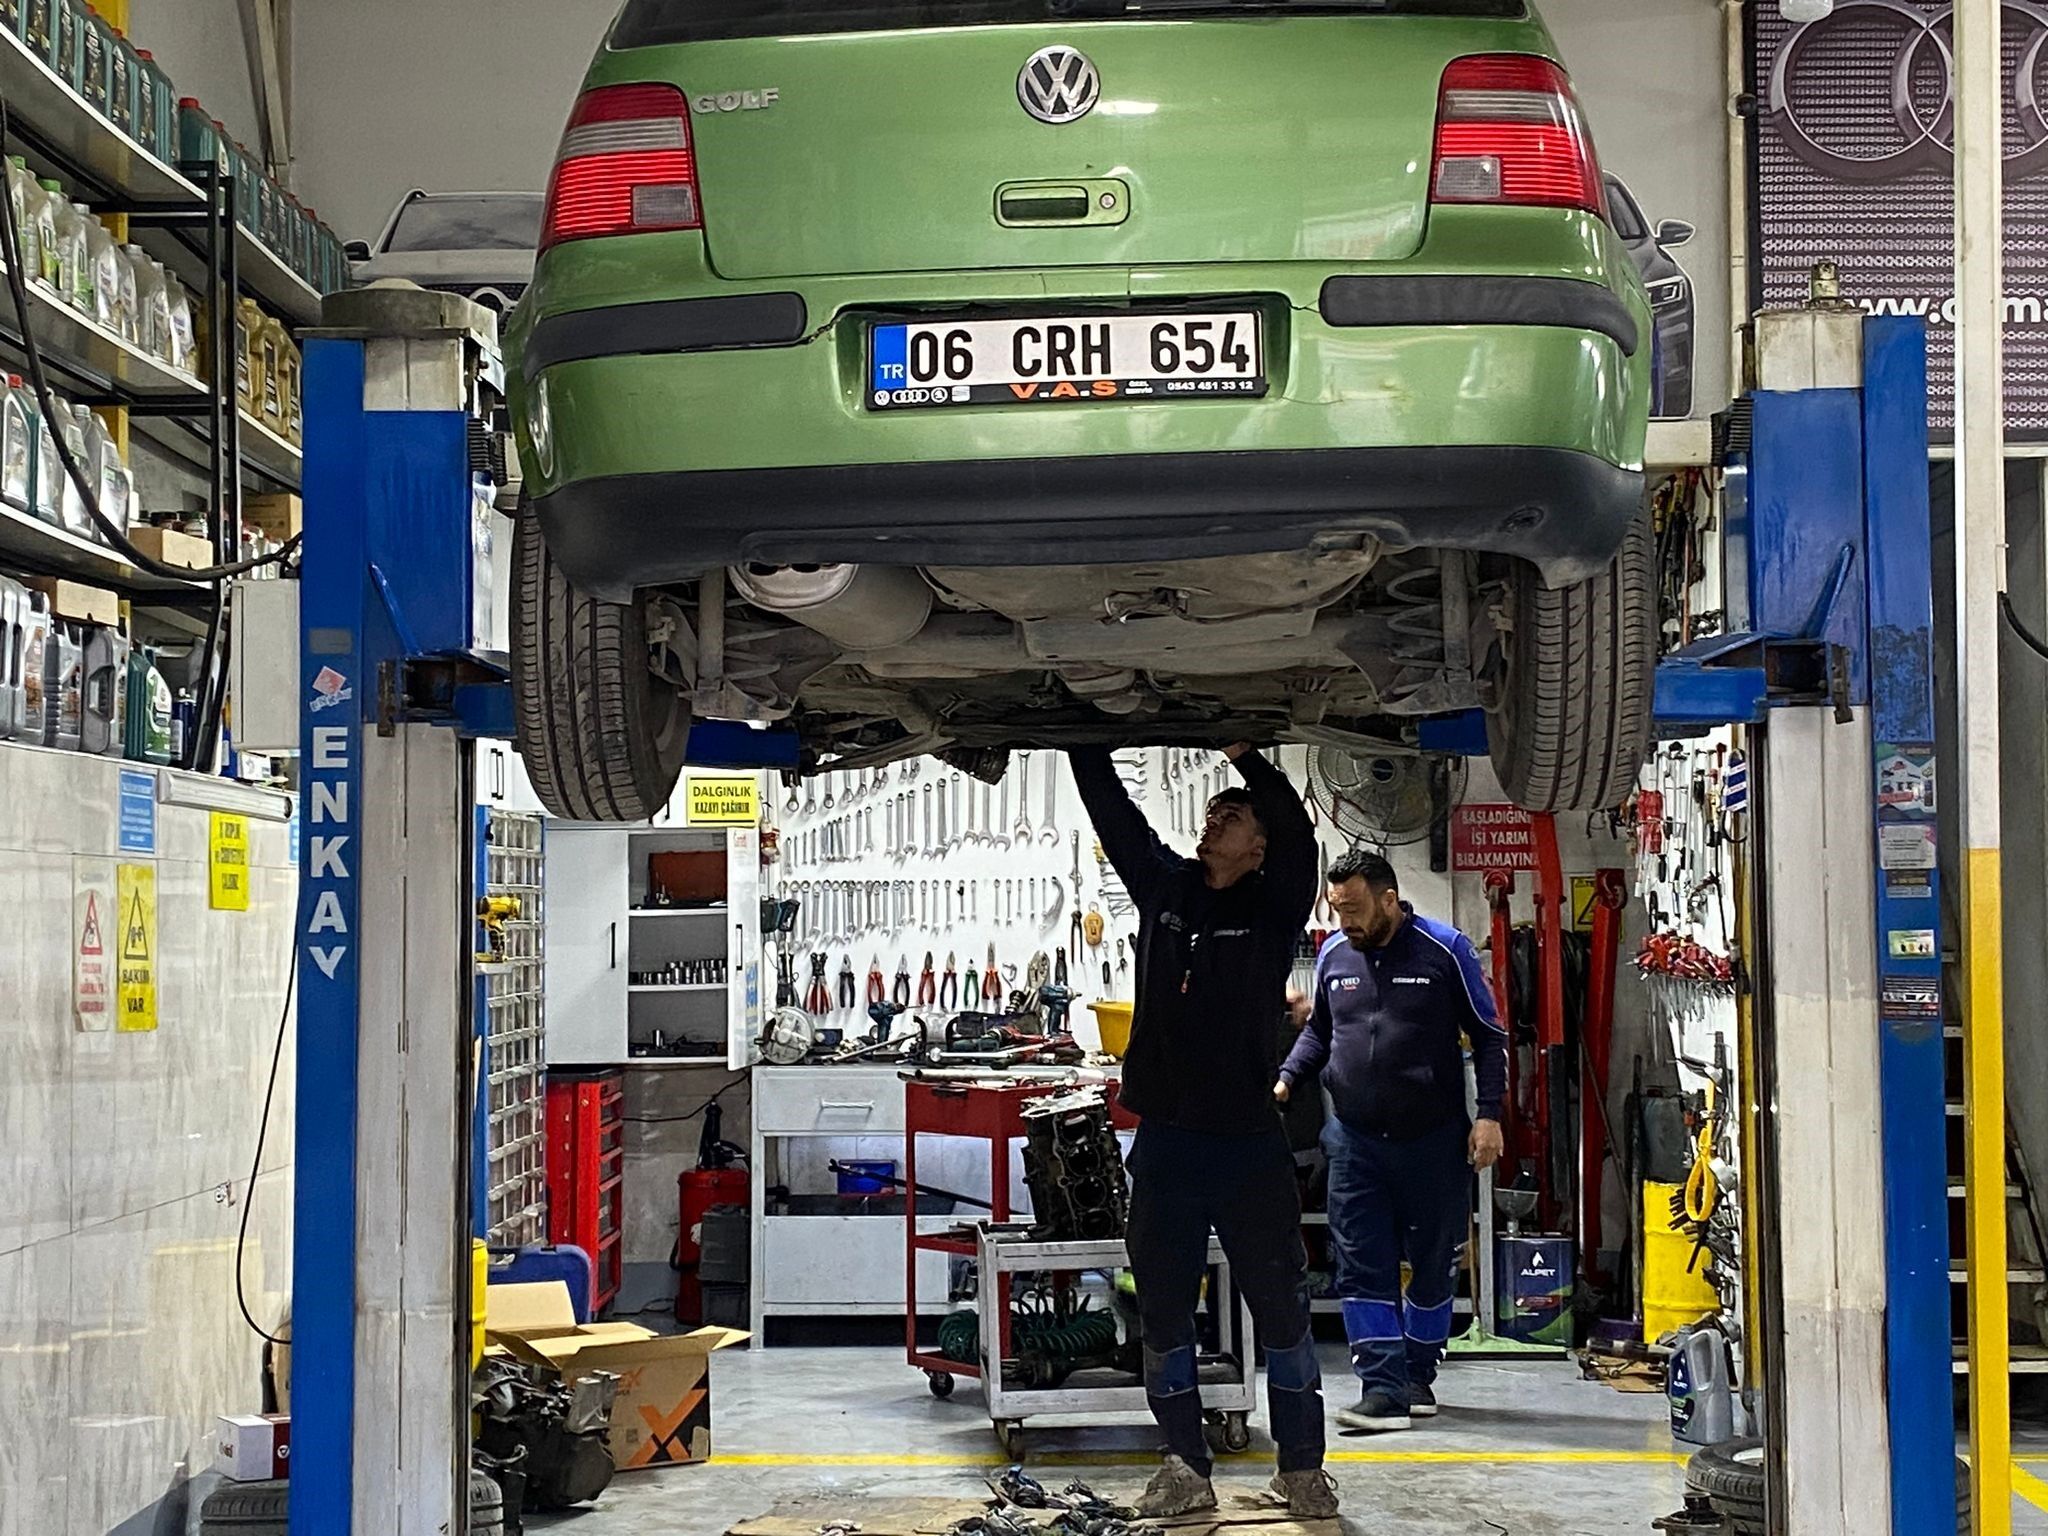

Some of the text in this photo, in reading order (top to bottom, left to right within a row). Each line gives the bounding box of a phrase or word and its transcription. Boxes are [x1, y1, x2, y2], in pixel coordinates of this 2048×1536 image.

[691, 87, 779, 114] GOLF
[910, 321, 1250, 382] 06 CRH 654
[880, 363, 904, 379] TR
[1009, 380, 1118, 399] V.A.S
[1221, 381, 1236, 390] 33
[1239, 380, 1254, 390] 12
[693, 786, 751, 797] DALGINLIK
[1490, 831, 1529, 846] YARIM
[308, 727, 350, 980] ENKAY
[1520, 1268, 1556, 1277] ALPET
